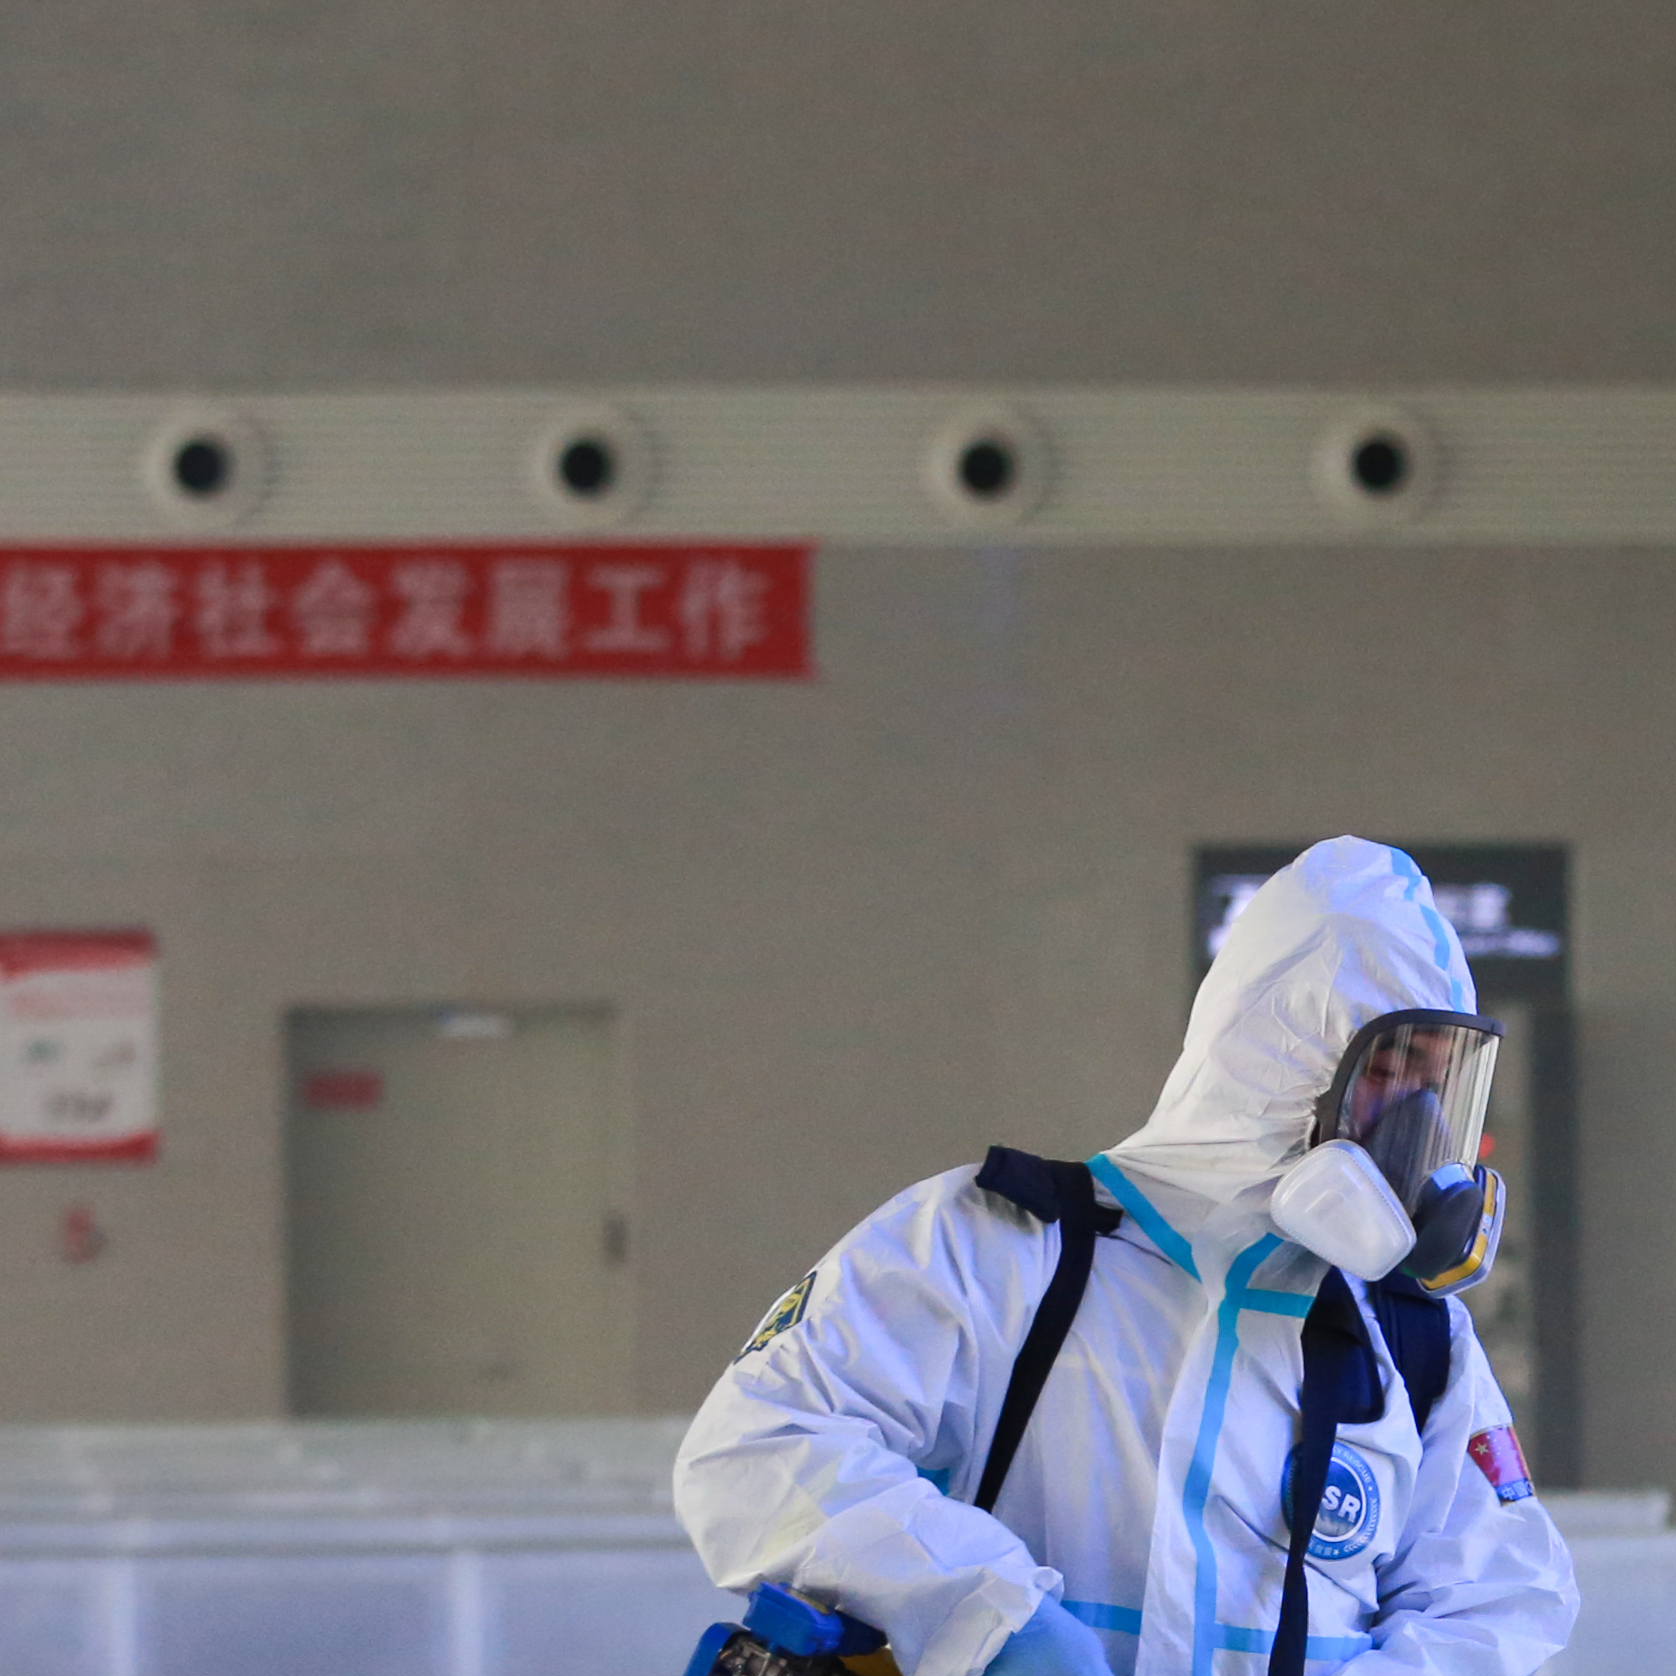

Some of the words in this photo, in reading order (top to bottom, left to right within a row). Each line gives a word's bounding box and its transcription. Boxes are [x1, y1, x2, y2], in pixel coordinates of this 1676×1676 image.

[2, 556, 774, 660] 经济社会发展工作
[1321, 1485, 1361, 1523] SR
